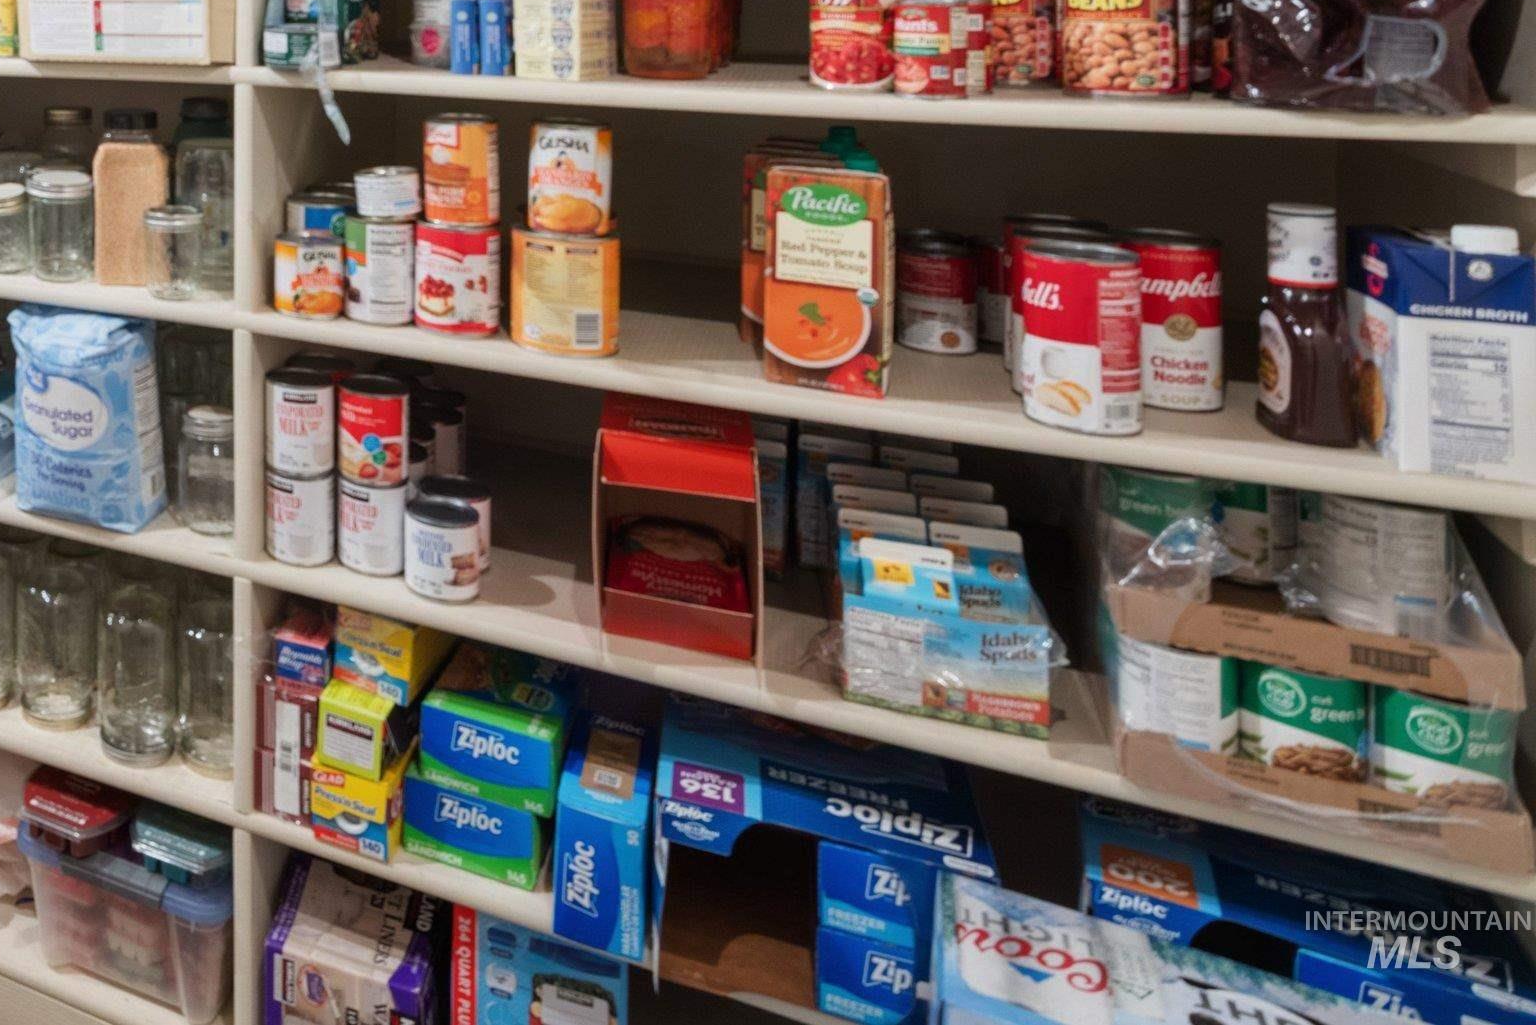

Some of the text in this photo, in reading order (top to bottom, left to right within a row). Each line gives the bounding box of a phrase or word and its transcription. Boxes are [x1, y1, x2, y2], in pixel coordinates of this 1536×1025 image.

[789, 186, 862, 216] Pacific
[809, 243, 855, 262] Pepper
[1409, 302, 1529, 324] CHICKEN BROTH
[1150, 354, 1209, 374] Chicken
[1153, 369, 1207, 387] Noodle
[24, 396, 94, 422] Granulated
[51, 419, 95, 441] Sugar
[1309, 706, 1354, 725] green
[456, 723, 520, 766] Ziploc
[312, 771, 345, 787] GLAD
[679, 778, 737, 804] 136
[438, 795, 503, 836] Ziploc
[663, 800, 715, 823] Ziploc
[825, 797, 963, 852] Ziploc
[566, 841, 596, 908] Ziploc
[1100, 887, 1170, 920] Ziploc
[373, 912, 404, 965] LINERS
[961, 906, 1096, 956] LIGHT
[457, 945, 473, 994] QUART
[956, 920, 1109, 994] Coors
[457, 996, 472, 1025] PLU
